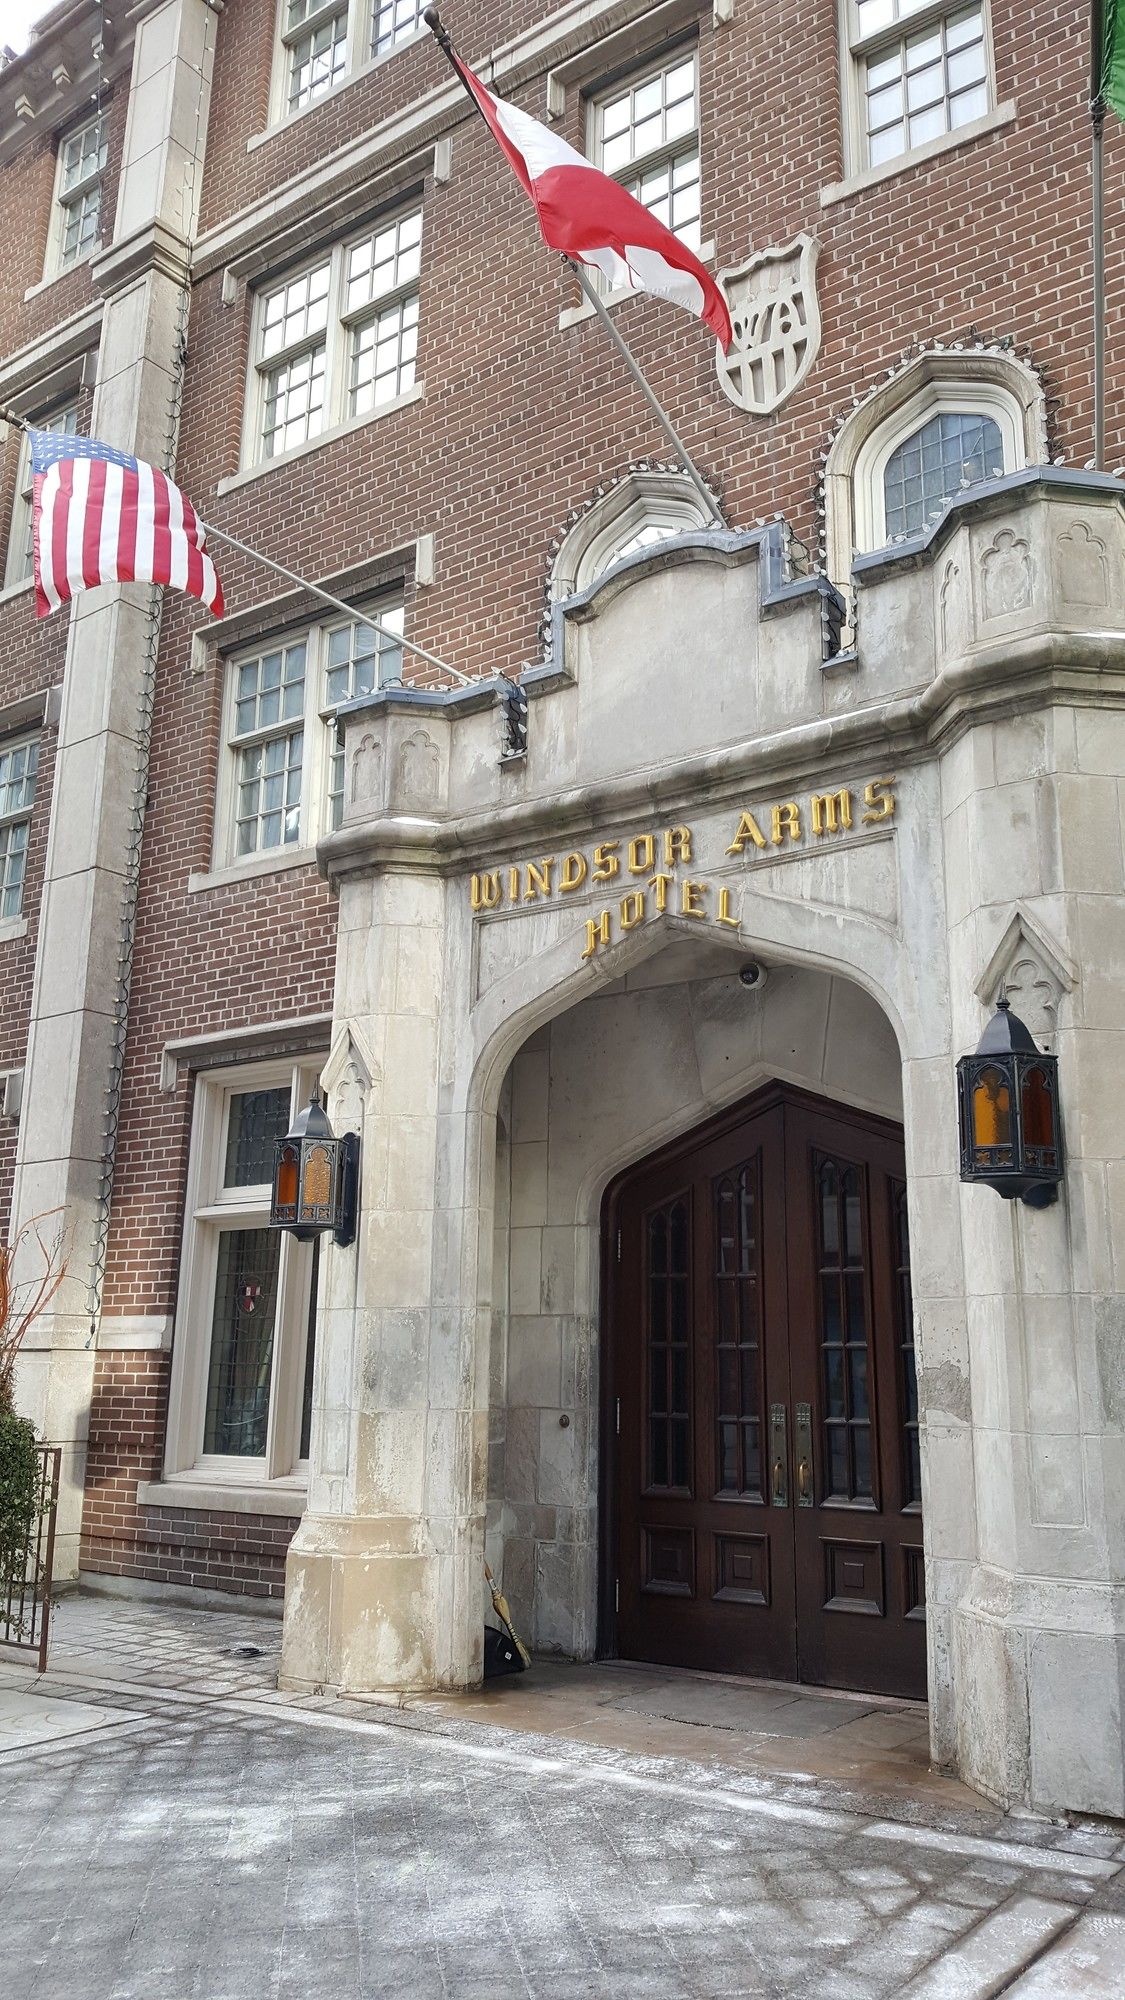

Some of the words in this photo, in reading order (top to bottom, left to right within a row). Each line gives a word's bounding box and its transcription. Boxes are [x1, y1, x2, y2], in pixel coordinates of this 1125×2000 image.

[470, 824, 692, 912] WINDSOR
[725, 775, 897, 855] ARMS
[581, 872, 742, 959] HOTEL
